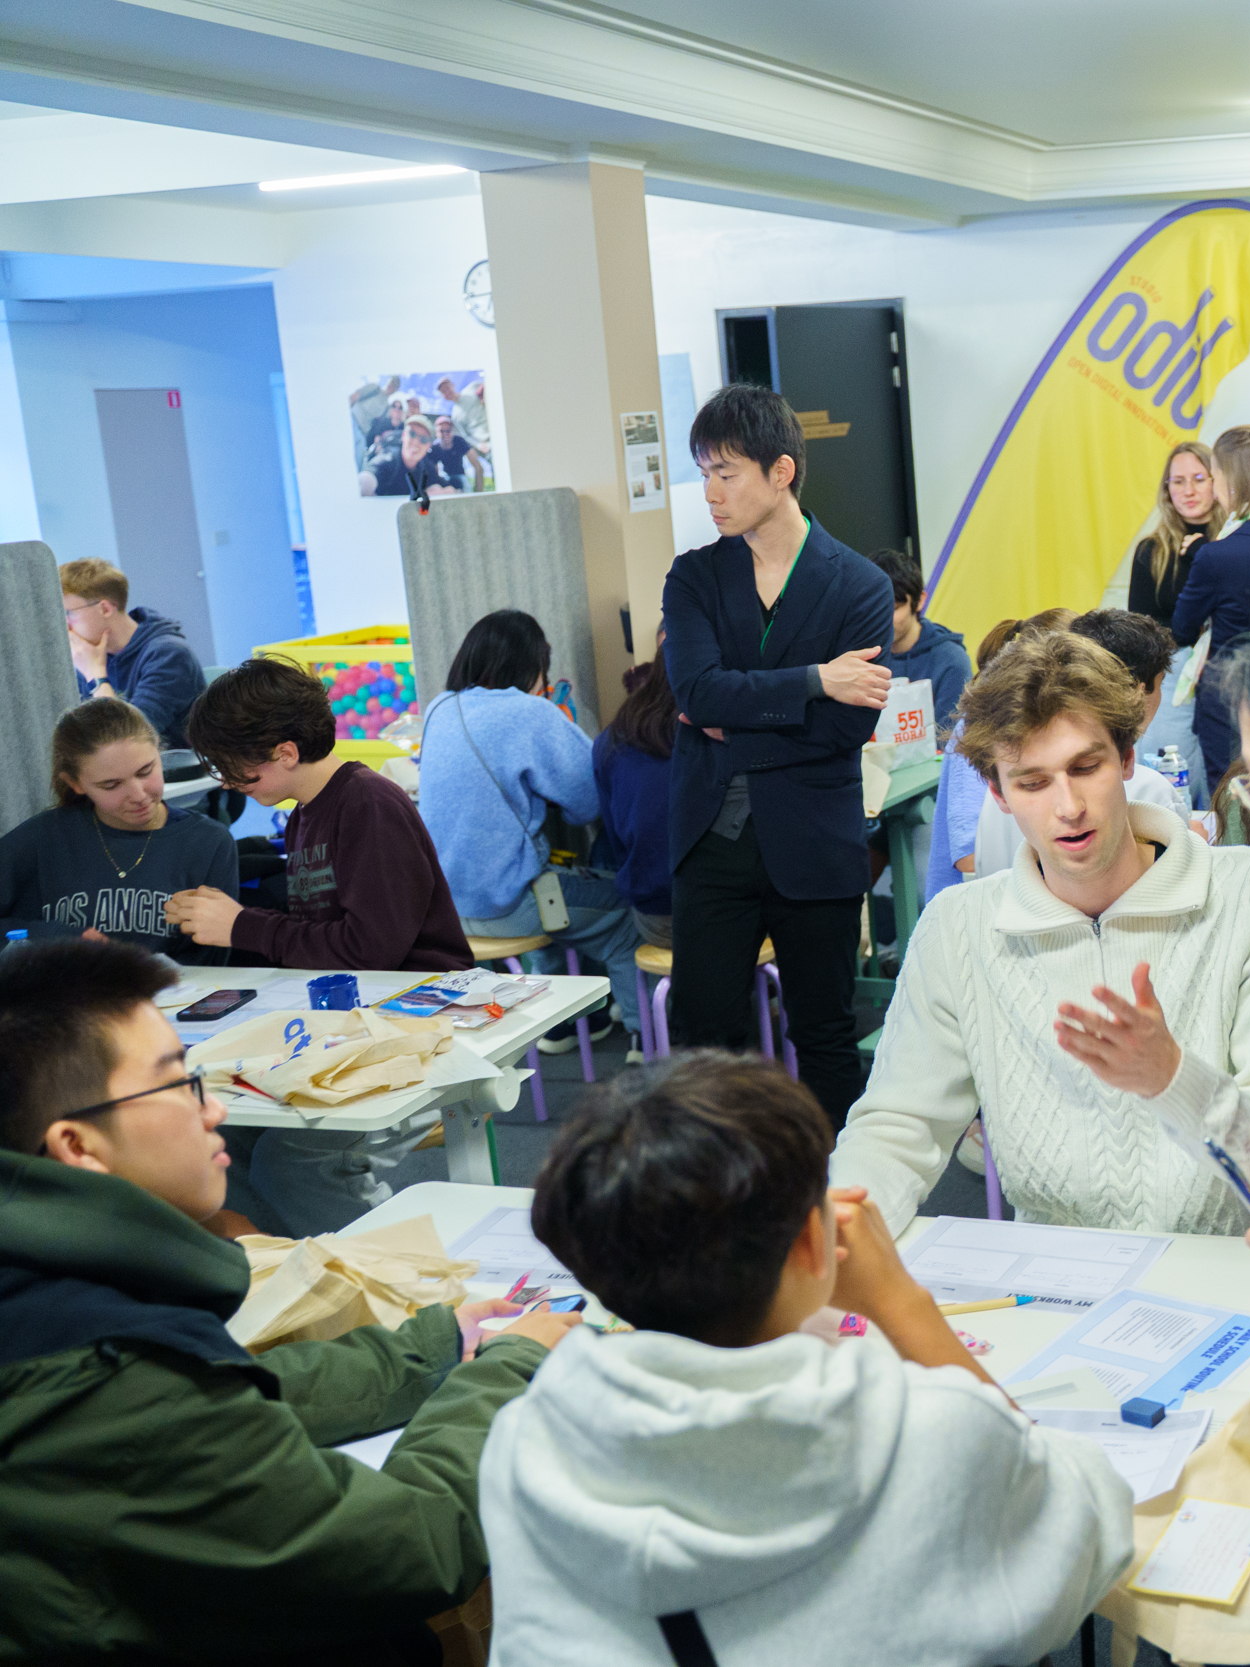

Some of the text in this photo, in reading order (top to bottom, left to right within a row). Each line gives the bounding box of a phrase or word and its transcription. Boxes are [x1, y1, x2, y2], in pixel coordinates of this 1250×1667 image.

[1067, 355, 1092, 379] OPEN
[1090, 374, 1123, 403] DIGITAL
[1122, 397, 1169, 440] INNOVATION
[897, 709, 924, 731] 551
[1007, 1292, 1073, 1306] WORKST
[1201, 1330, 1238, 1359] SCHEDULE
[1208, 1345, 1240, 1366] SCHOOL
